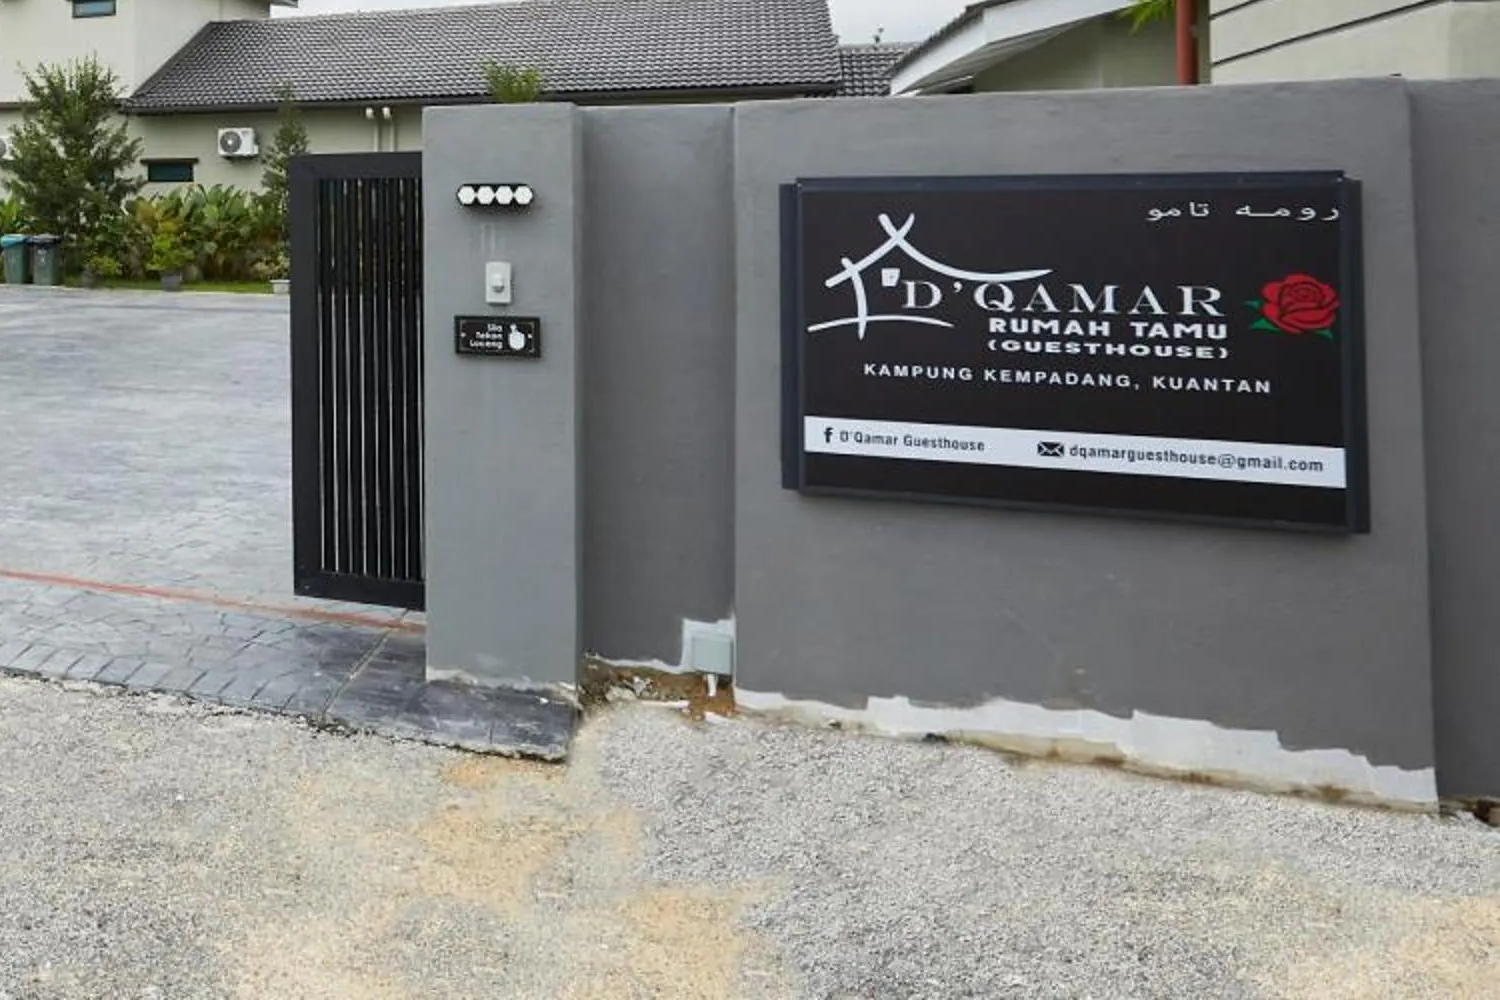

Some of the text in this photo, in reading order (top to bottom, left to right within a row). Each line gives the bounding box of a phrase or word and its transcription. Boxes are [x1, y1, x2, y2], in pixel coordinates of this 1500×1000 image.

[988, 317, 1228, 340] RUMAH TAMU
[987, 339, 1229, 360] (GUESTHOUSE)
[863, 362, 1271, 394] KAMPUNG KEMPADANG, KUANTAN
[902, 434, 986, 452] Guesthouse
[1069, 444, 1323, 472] dqamarguesthouse@gmail.com
